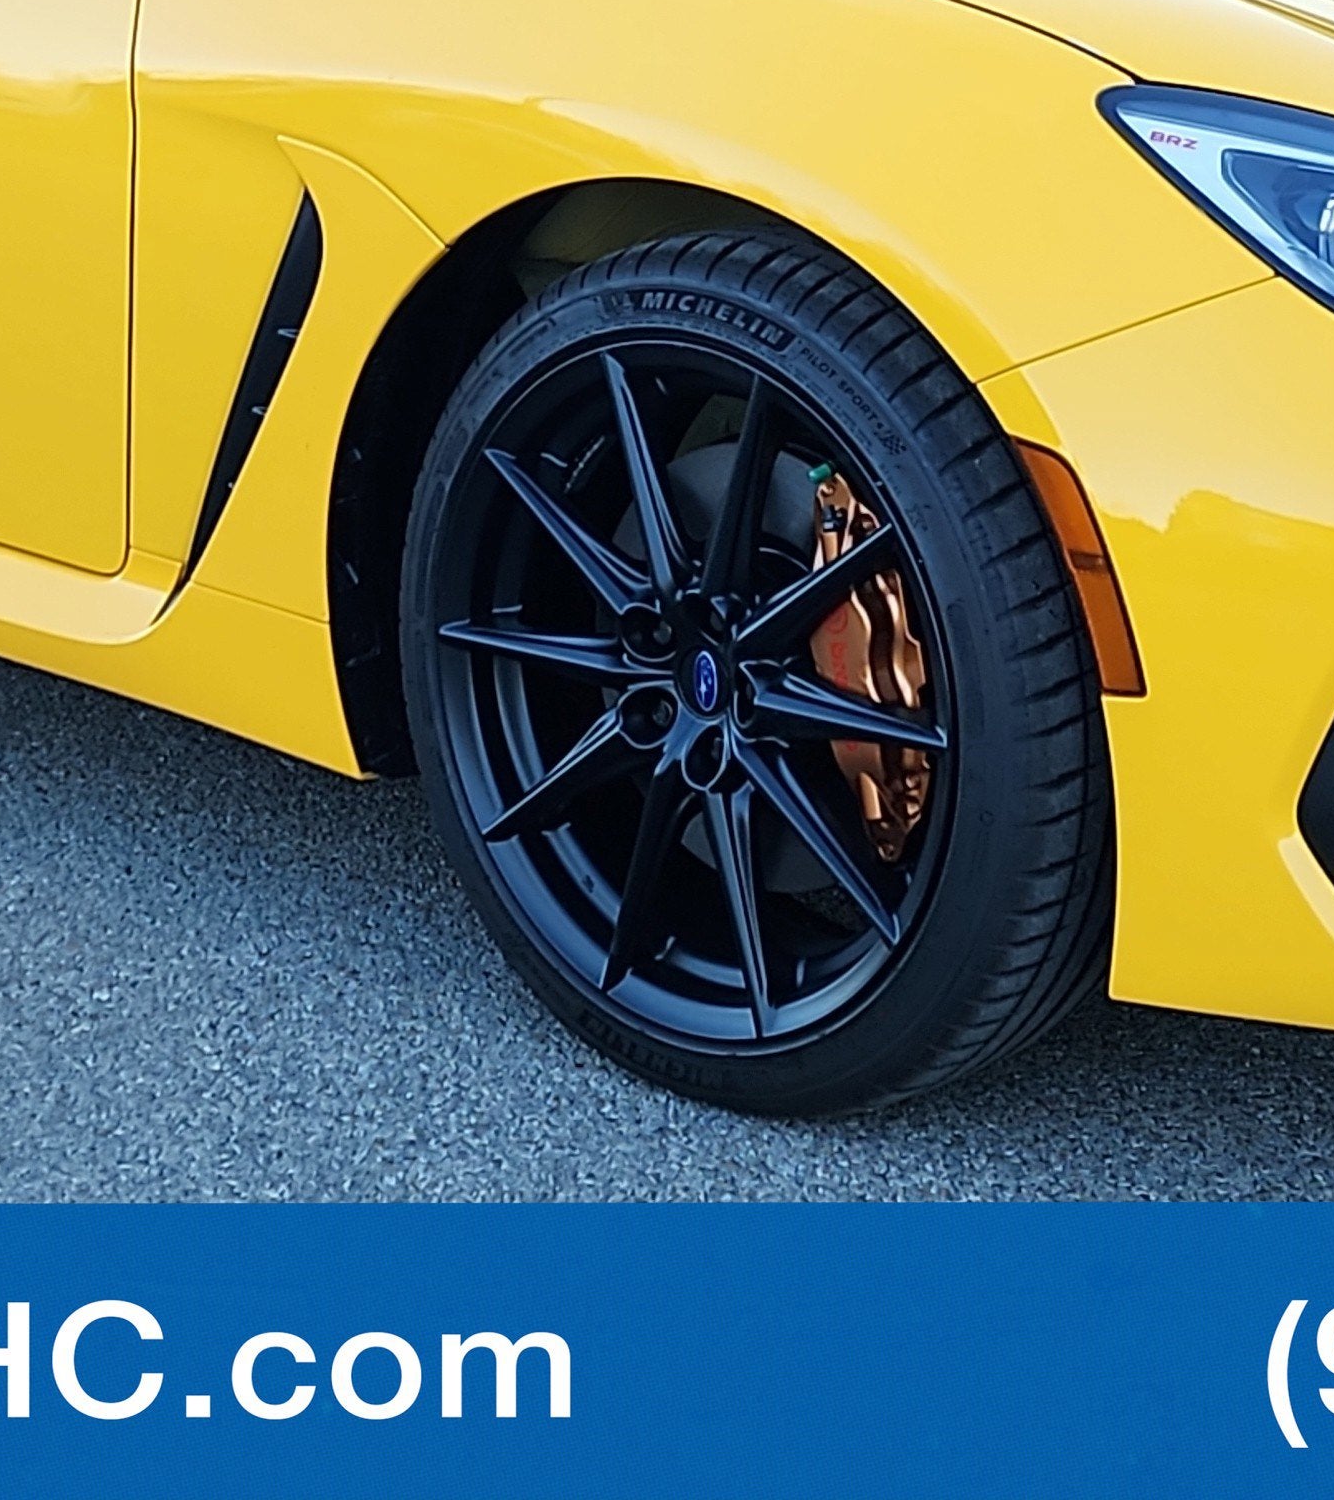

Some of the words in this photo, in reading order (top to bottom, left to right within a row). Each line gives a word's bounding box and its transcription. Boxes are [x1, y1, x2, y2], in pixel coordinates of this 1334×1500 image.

[1150, 130, 1198, 150] BRZ
[640, 291, 785, 346] MICHELIN
[800, 347, 837, 380] PILOT
[838, 380, 879, 422] SPORT
